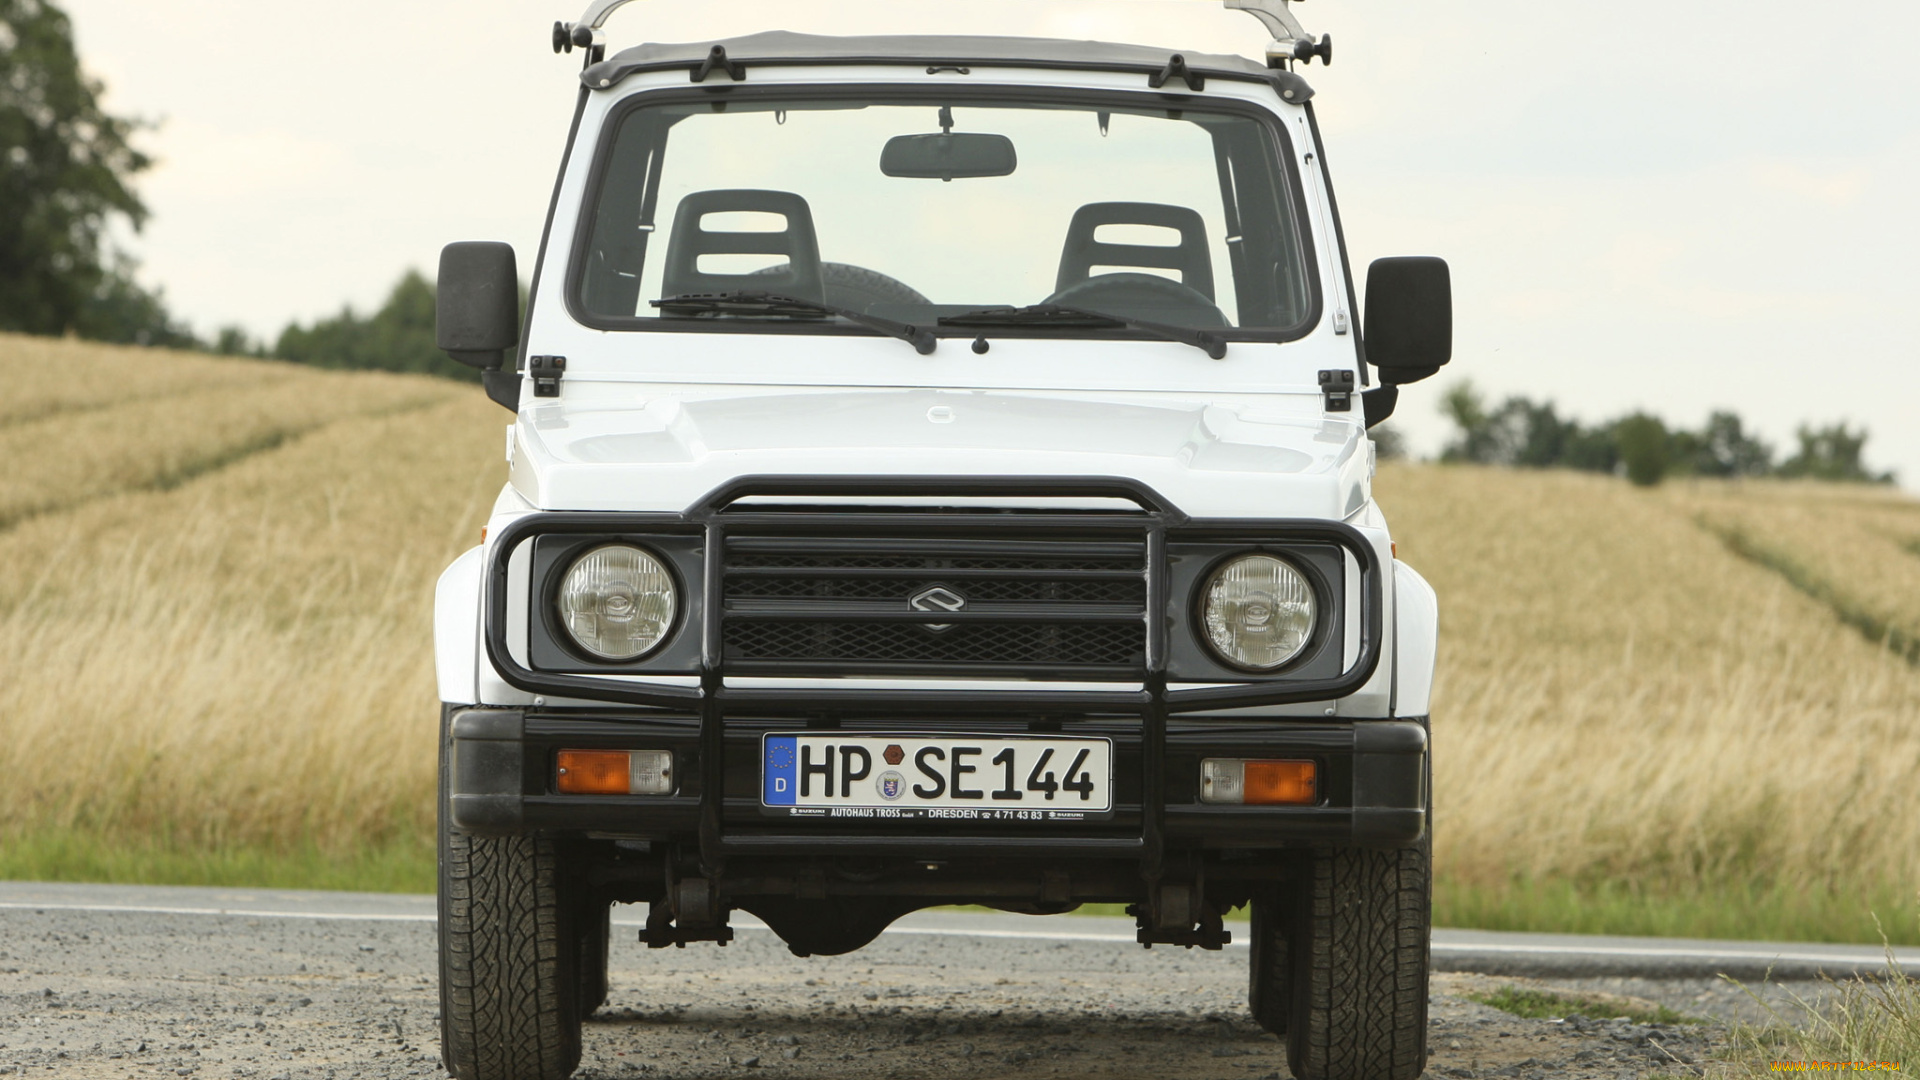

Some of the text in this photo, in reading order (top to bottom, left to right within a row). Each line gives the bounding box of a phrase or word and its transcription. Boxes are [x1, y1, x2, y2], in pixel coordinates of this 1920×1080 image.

[800, 744, 872, 798] HP
[912, 745, 1095, 800] SE144
[775, 778, 787, 793] D
[830, 808, 874, 818] AUTOHAUS
[877, 808, 901, 818] TROSS
[928, 808, 978, 819] DRESDEN
